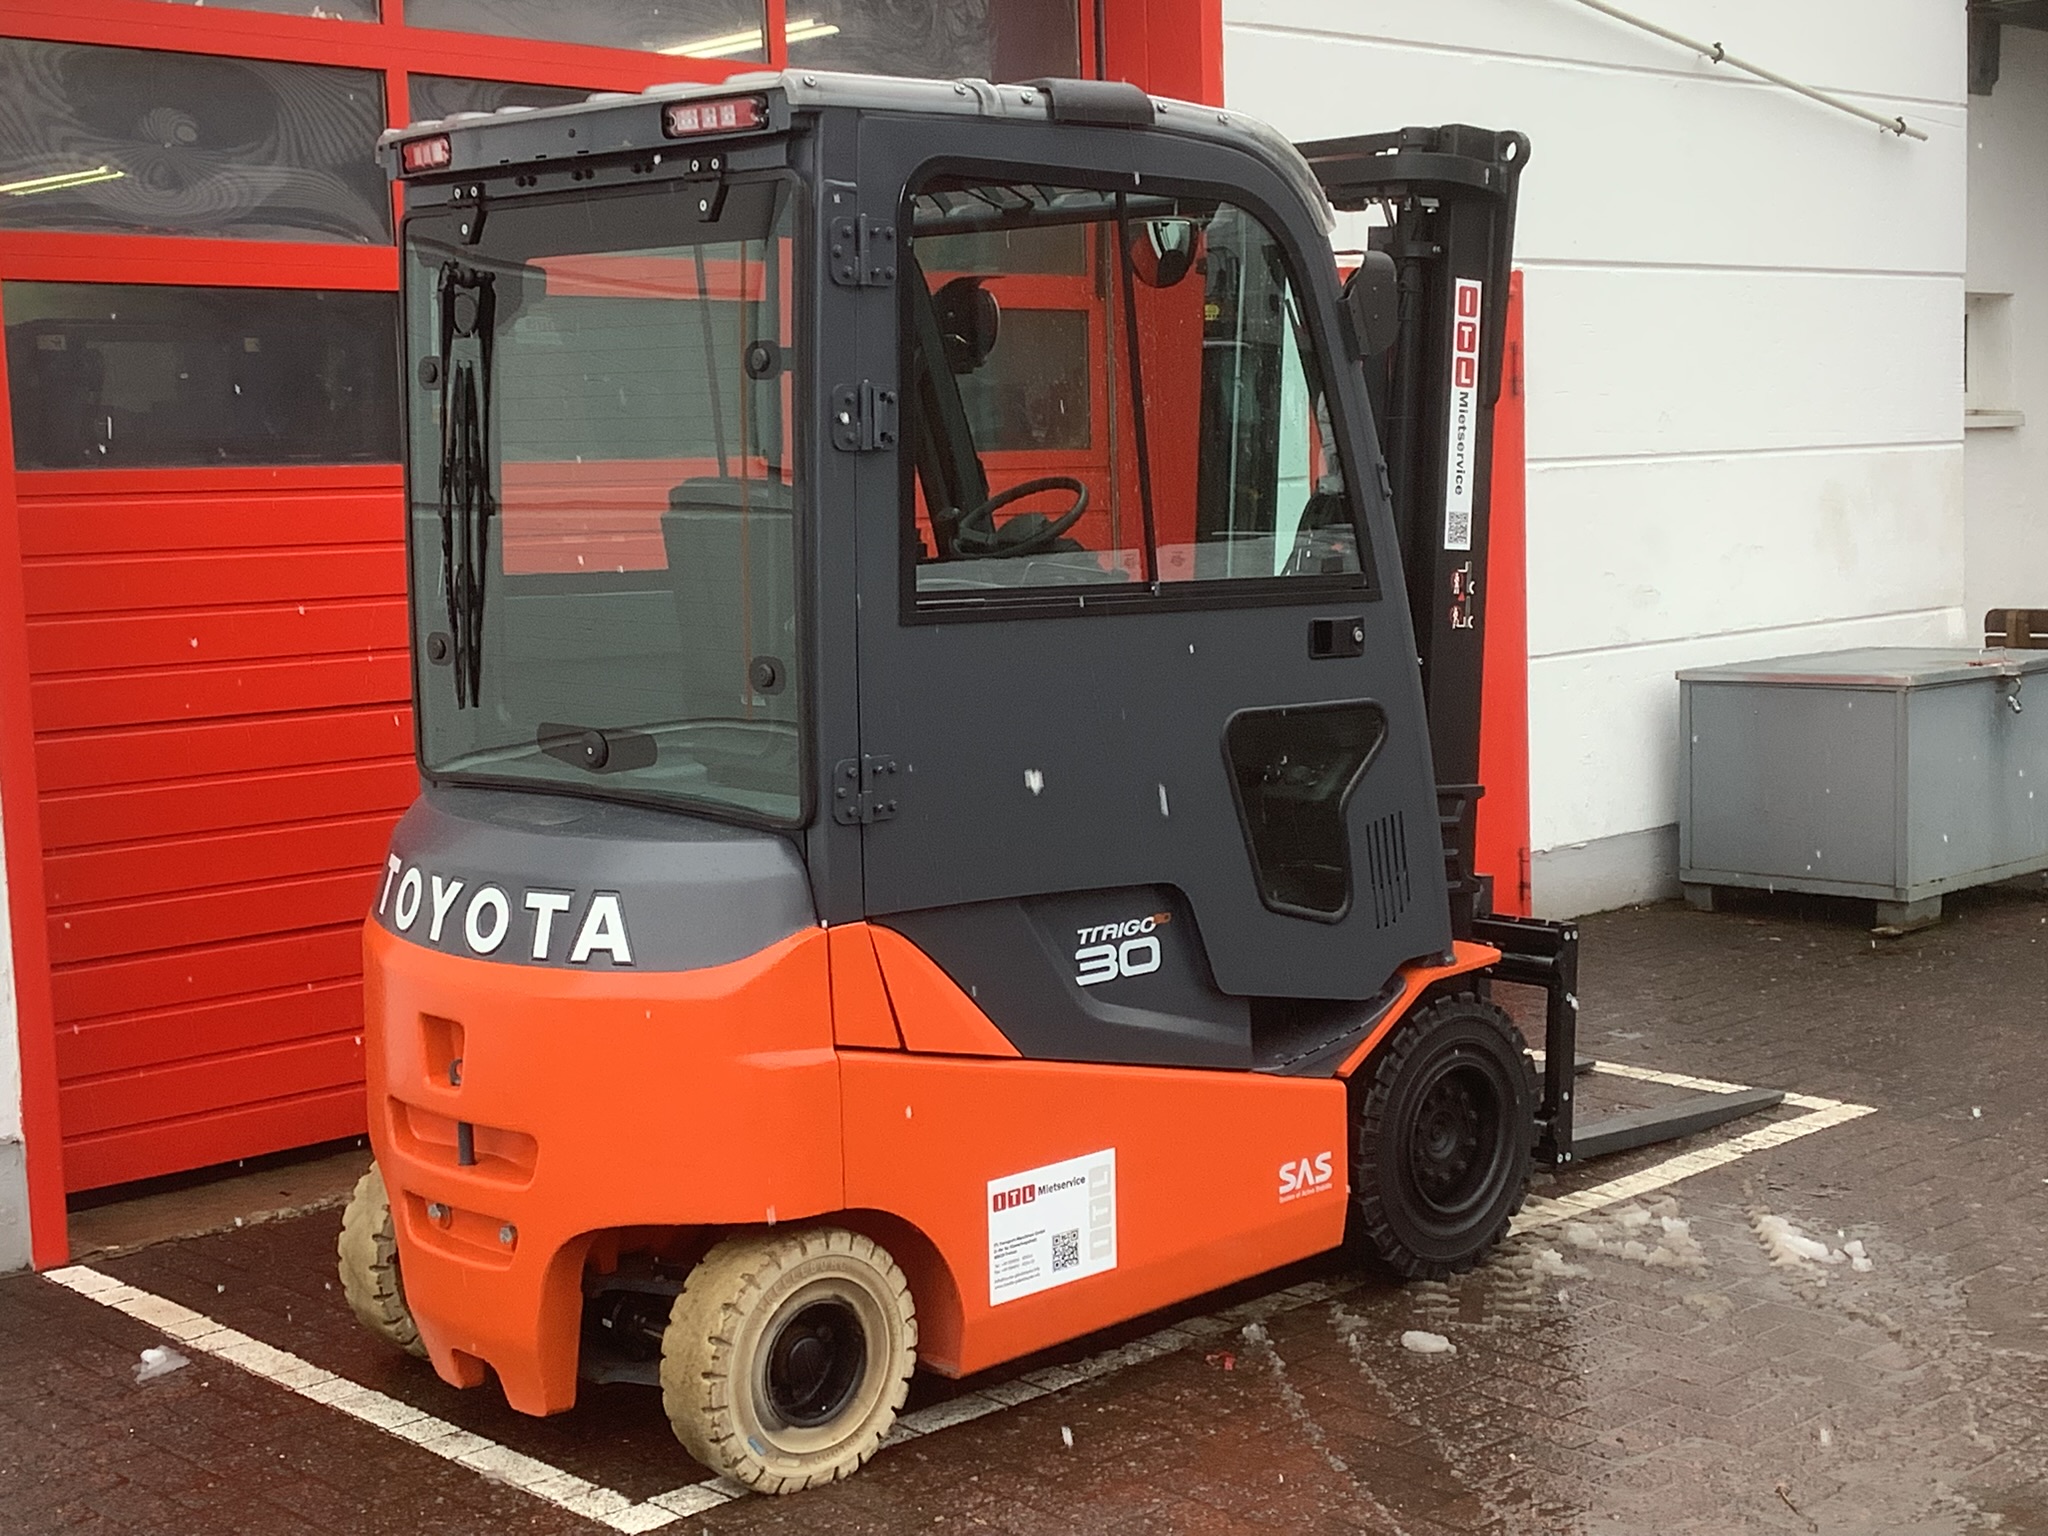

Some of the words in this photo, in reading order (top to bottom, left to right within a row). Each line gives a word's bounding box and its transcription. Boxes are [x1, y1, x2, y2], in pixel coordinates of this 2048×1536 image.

[1459, 289, 1474, 385] ITL
[1455, 391, 1469, 496] Mietservice
[379, 853, 632, 962] TOYOTA
[1075, 936, 1161, 986] 30
[995, 1185, 1035, 1211] ITL
[1038, 1176, 1086, 1196] Mietservice
[1279, 1151, 1333, 1195] SAS
